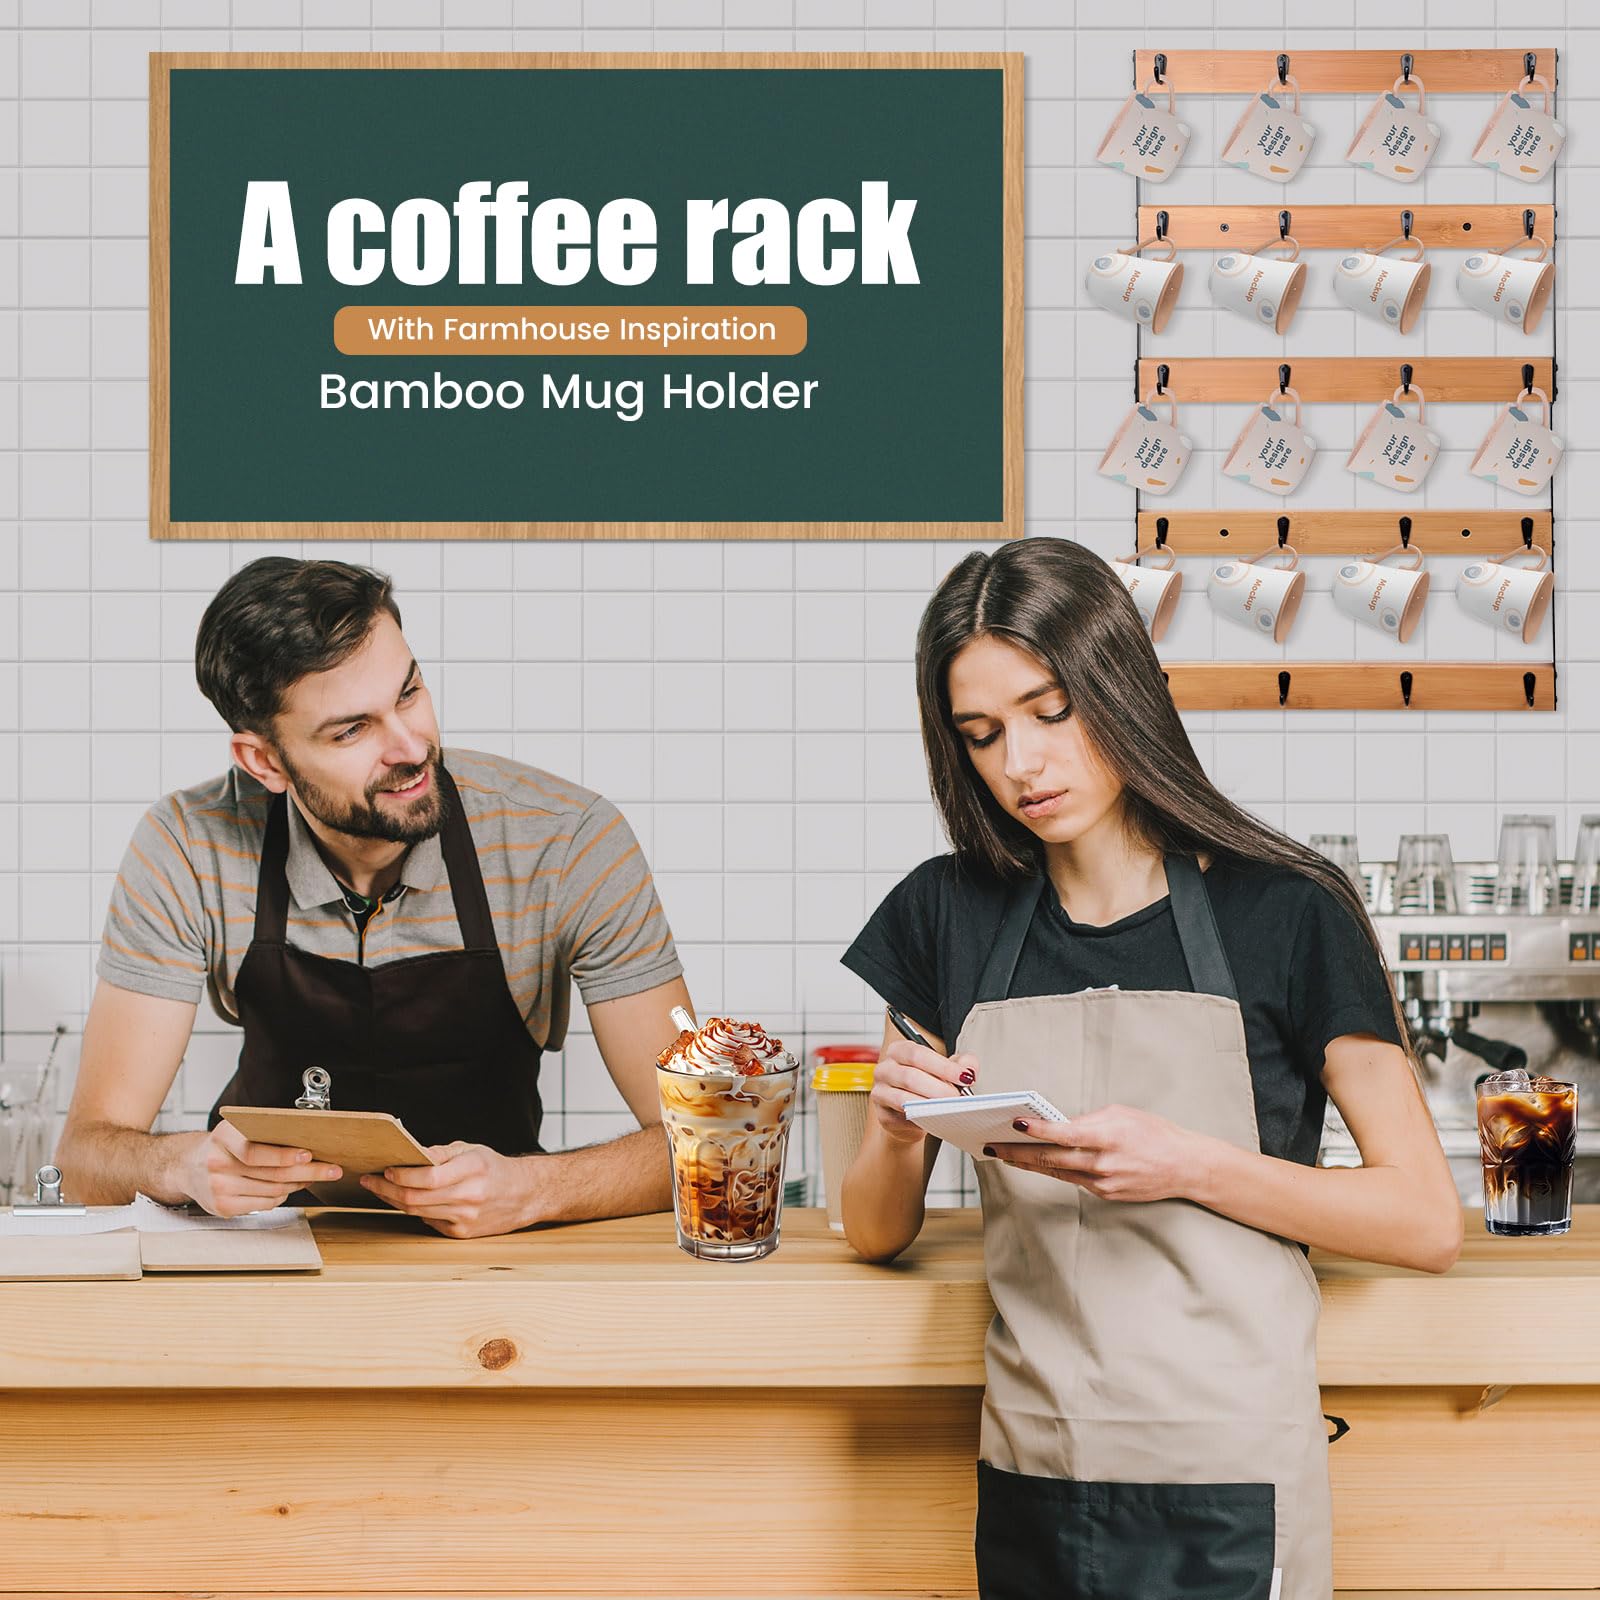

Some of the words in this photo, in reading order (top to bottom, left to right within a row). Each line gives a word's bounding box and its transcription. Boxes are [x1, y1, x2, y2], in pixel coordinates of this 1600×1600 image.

[1132, 124, 1148, 148] your
[1138, 125, 1160, 156] design
[1148, 135, 1166, 157] here
[1257, 124, 1273, 148] your
[1263, 125, 1285, 156] design
[1273, 135, 1291, 157] here
[1382, 124, 1398, 148] your
[1388, 125, 1410, 156] design
[1398, 135, 1416, 157] here
[1507, 124, 1523, 148] your
[1513, 125, 1535, 156] design
[1523, 135, 1541, 157] here
[234, 180, 303, 285] A
[327, 180, 658, 286] coffee
[686, 180, 921, 286] rack
[1122, 269, 1141, 302] Mockup
[1245, 269, 1264, 302] Mockup
[1369, 269, 1388, 302] Mockup
[1493, 269, 1512, 302] Mockup
[367, 316, 434, 341] With
[444, 316, 610, 341] Farmhouse
[620, 316, 777, 347] Inspiration
[320, 371, 525, 410] Bamboo
[542, 373, 645, 422] Mug
[663, 371, 819, 410] Holder
[1134, 436, 1150, 460] your
[1140, 437, 1162, 468] design
[1150, 447, 1168, 469] here
[1258, 437, 1274, 461] your
[1264, 438, 1286, 469] design
[1274, 448, 1292, 470] here
[1382, 434, 1398, 458] your
[1388, 435, 1410, 466] design
[1398, 445, 1416, 467] here
[1505, 437, 1521, 461] your
[1511, 438, 1533, 469] design
[1521, 448, 1539, 470] here
[1244, 578, 1263, 611] Mockup
[1368, 578, 1387, 611] Mockup
[1492, 578, 1511, 611] Mockup
